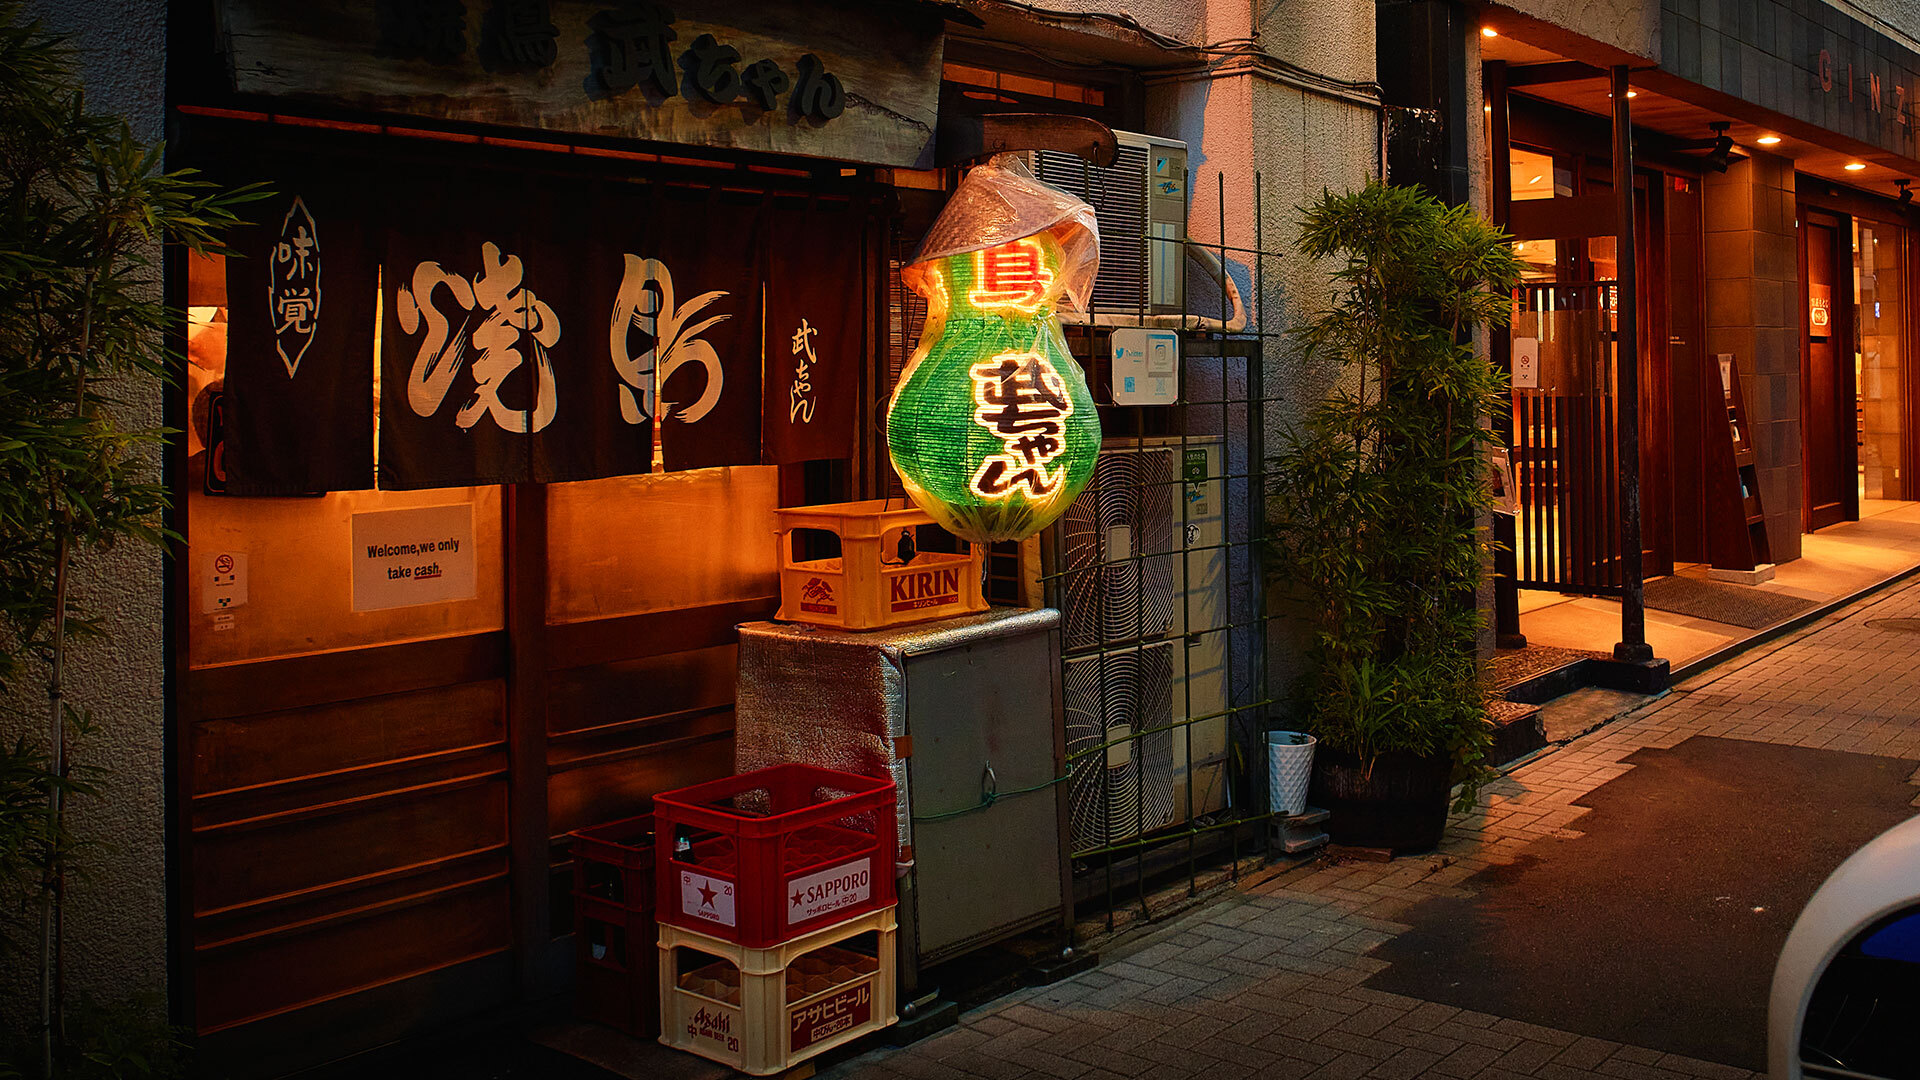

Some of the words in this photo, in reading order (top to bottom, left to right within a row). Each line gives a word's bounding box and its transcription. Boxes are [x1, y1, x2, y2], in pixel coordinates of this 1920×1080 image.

[1818, 48, 1906, 125] GINZ
[275, 228, 316, 336] 味覚
[789, 319, 818, 425] 武ちゃん
[971, 353, 1072, 497] 武ちゃん
[367, 541, 435, 559] Welcome,we
[438, 537, 460, 553] only
[388, 564, 411, 580] take
[414, 562, 442, 579] cash.
[890, 568, 959, 602] KIRIN
[723, 885, 733, 896] 20
[807, 870, 869, 904] SAPPORO
[807, 900, 841, 917] サッポロビール
[694, 1006, 730, 1034] Asahi
[792, 987, 870, 1032] アサヒビール
[688, 1024, 698, 1039] 中
[728, 1036, 739, 1052] 20
